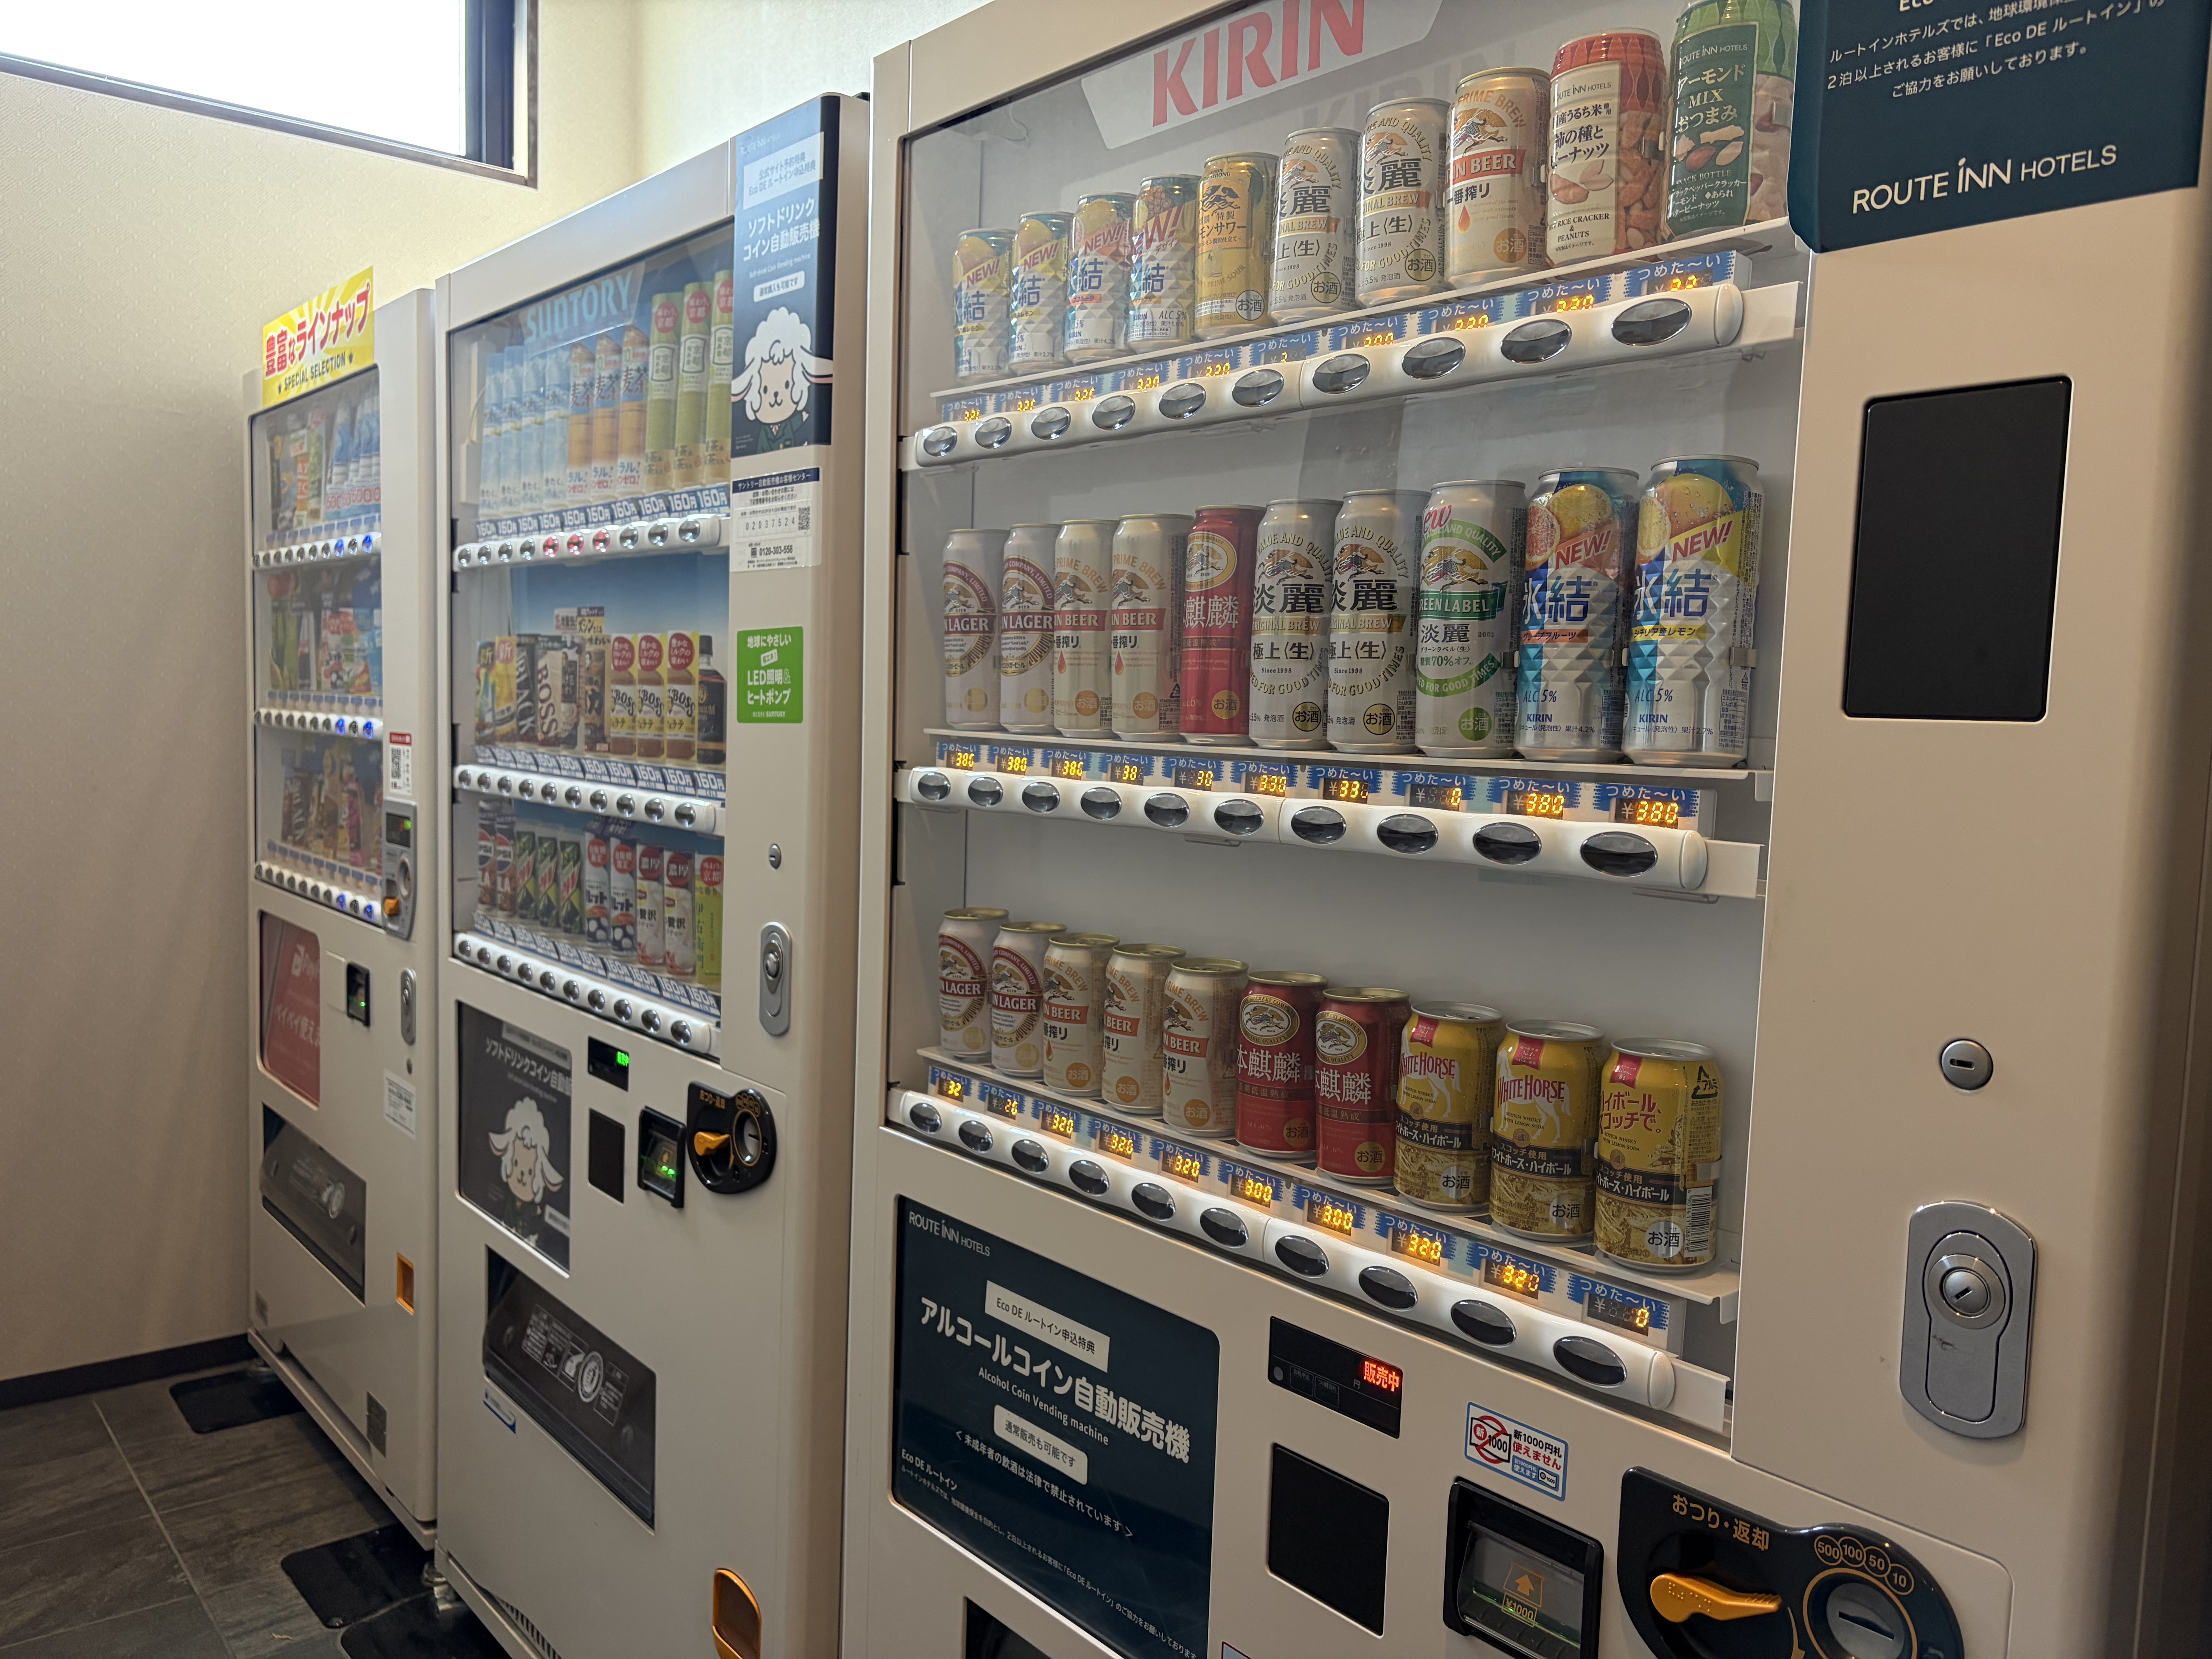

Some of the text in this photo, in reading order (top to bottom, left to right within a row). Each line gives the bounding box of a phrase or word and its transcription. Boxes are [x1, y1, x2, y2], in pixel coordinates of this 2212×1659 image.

[2026, 22, 2047, 39] DE
[1152, 0, 1365, 127] KIRIN
[1892, 41, 2087, 98] ご協力をお願いしております。
[1688, 88, 1724, 109] MIX
[1678, 105, 1738, 134] おつまみ
[1471, 153, 1516, 173] BEER
[1698, 169, 1732, 180] BOTTLE
[1853, 172, 1948, 214] ROUTE
[2020, 144, 2117, 182] HOTELS
[1386, 194, 1420, 206] BREW
[1447, 183, 1491, 204] 一番搾り
[748, 198, 815, 239] ソフトドリンク
[1557, 212, 1610, 228] RICE CRACKER
[1084, 223, 1123, 254] NEW!
[1557, 230, 1589, 242] PEANUTS
[1023, 243, 1059, 271] NEW!
[967, 259, 1000, 288] NEW!
[1313, 281, 1338, 295] お酒
[1237, 297, 1262, 313] お酒
[265, 280, 371, 378] 豊富なラインナップ
[284, 351, 346, 392] SPECIAL SELECTION
[698, 488, 728, 508] 160円
[1444, 524, 1462, 535] AND
[1555, 529, 1612, 570] NEW!
[1672, 520, 1733, 563] NEW!
[1252, 583, 1325, 614] 淡麗
[1522, 575, 1592, 625] 氷結
[1633, 568, 1712, 620] 氷結
[1444, 598, 1491, 613] LABEL
[948, 617, 989, 632] LAGER
[1009, 616, 1053, 629] LAGER
[1065, 615, 1099, 627] BEER
[1122, 614, 1157, 626] BEER
[1252, 619, 1321, 631] ORIGINAL BREW
[1358, 618, 1392, 630] BREW
[747, 634, 792, 649] 地球にやさしい
[1420, 623, 1470, 644] 淡麗
[1522, 630, 1577, 642] グレープフルーツ
[1633, 626, 1697, 639] シチリア産レモン
[1425, 659, 1496, 693] FOR GOOD TIMES
[747, 688, 792, 706] ヒートポンプ
[1523, 689, 1557, 703] ALC. 5%
[1635, 689, 1673, 703] ALC. 5%
[1264, 714, 1285, 723] 発泡酒
[1294, 711, 1320, 725] お酒
[1365, 712, 1392, 726] お酒
[1461, 715, 1489, 732] お酒
[1527, 713, 1553, 723] KIRIN
[1638, 713, 1669, 723] KIRIN
[1565, 724, 1595, 733] 果汁4.2%
[945, 981, 982, 996] LAGER
[998, 996, 1037, 1011] LAGER
[1051, 1007, 1081, 1022] BEER
[1170, 1038, 1201, 1054] BEER
[1237, 1044, 1302, 1084] 本麒麟
[1419, 1051, 1456, 1079] HORSE
[1497, 1074, 1566, 1109] WHITE HORSE
[1400, 1113, 1438, 1133] スコッチ使用
[1523, 1115, 1542, 1123] WHISKY
[1500, 1142, 1547, 1161] スコッチ使用
[1442, 1174, 1471, 1189] お酒
[1600, 1164, 1643, 1185] スコッチ使用
[1551, 1202, 1580, 1219] お酒
[908, 1210, 940, 1235] ROUTE
[960, 1236, 991, 1257] HOTELS
[1647, 1231, 1680, 1249] お酒
[996, 1297, 1096, 1355] Eco DE ルートイン申込特典
[920, 1296, 1190, 1464] アルコールコイン自動販売機
[1353, 1379, 1360, 1390] 円
[1363, 1360, 1400, 1393] 販売中
[978, 1366, 1109, 1446] Alcohol Coin Vending machine
[1476, 1426, 1485, 1439] 新
[1005, 1419, 1076, 1468] 通常販売も可能です
[1488, 1434, 1508, 1453] 1000
[1513, 1429, 1562, 1458] 新1000円札
[1512, 1441, 1562, 1471] 使えません
[901, 1448, 958, 1491] Eco DE ルートイン
[1513, 1464, 1537, 1479] 使えます
[1671, 1492, 1771, 1552] おつり・返却
[1817, 1542, 1841, 1561] 500
[1841, 1543, 1863, 1562] 100
[1869, 1554, 1886, 1571] 50
[1892, 1571, 1907, 1588] 10
[1505, 1598, 1534, 1621] ¥1000
